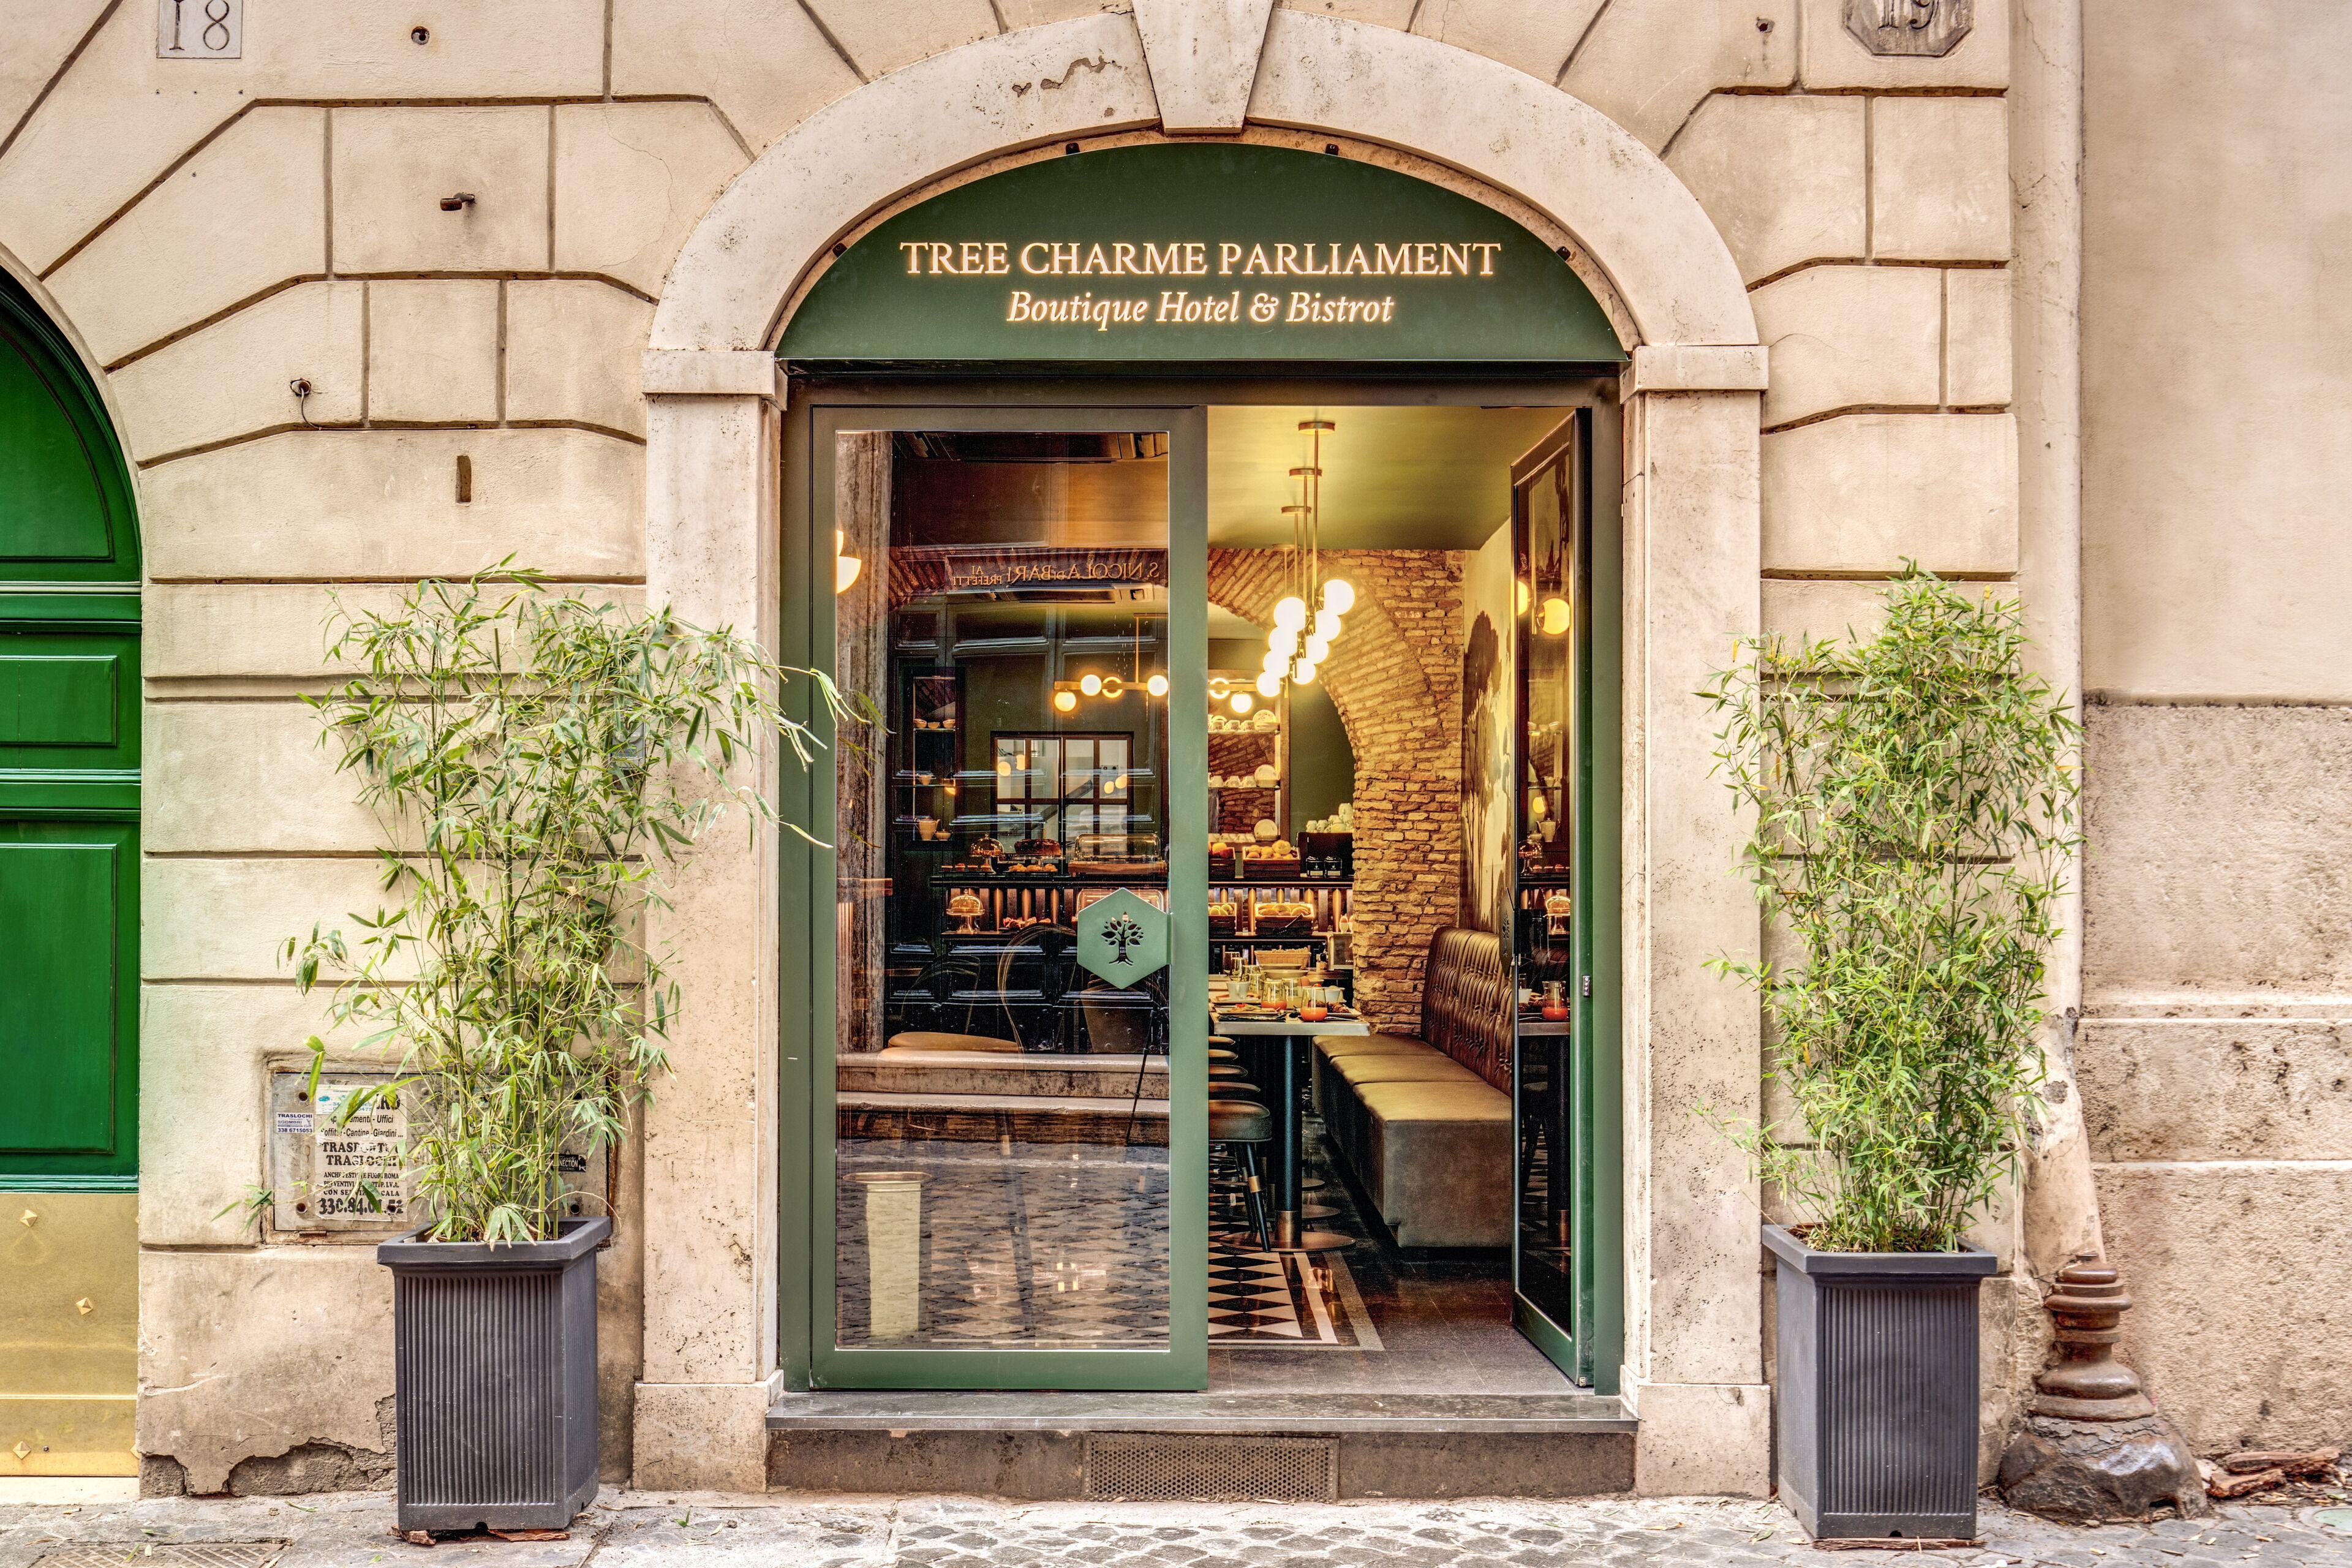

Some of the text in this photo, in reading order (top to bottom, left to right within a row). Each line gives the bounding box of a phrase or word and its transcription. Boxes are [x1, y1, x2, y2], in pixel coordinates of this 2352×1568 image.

[169, 0, 230, 50] 18
[899, 242, 1502, 275] TREE CHARME PARLIAMENT
[1006, 290, 1395, 332] Boutique Hotel & Bistrot
[377, 1115, 394, 1123] Uffici
